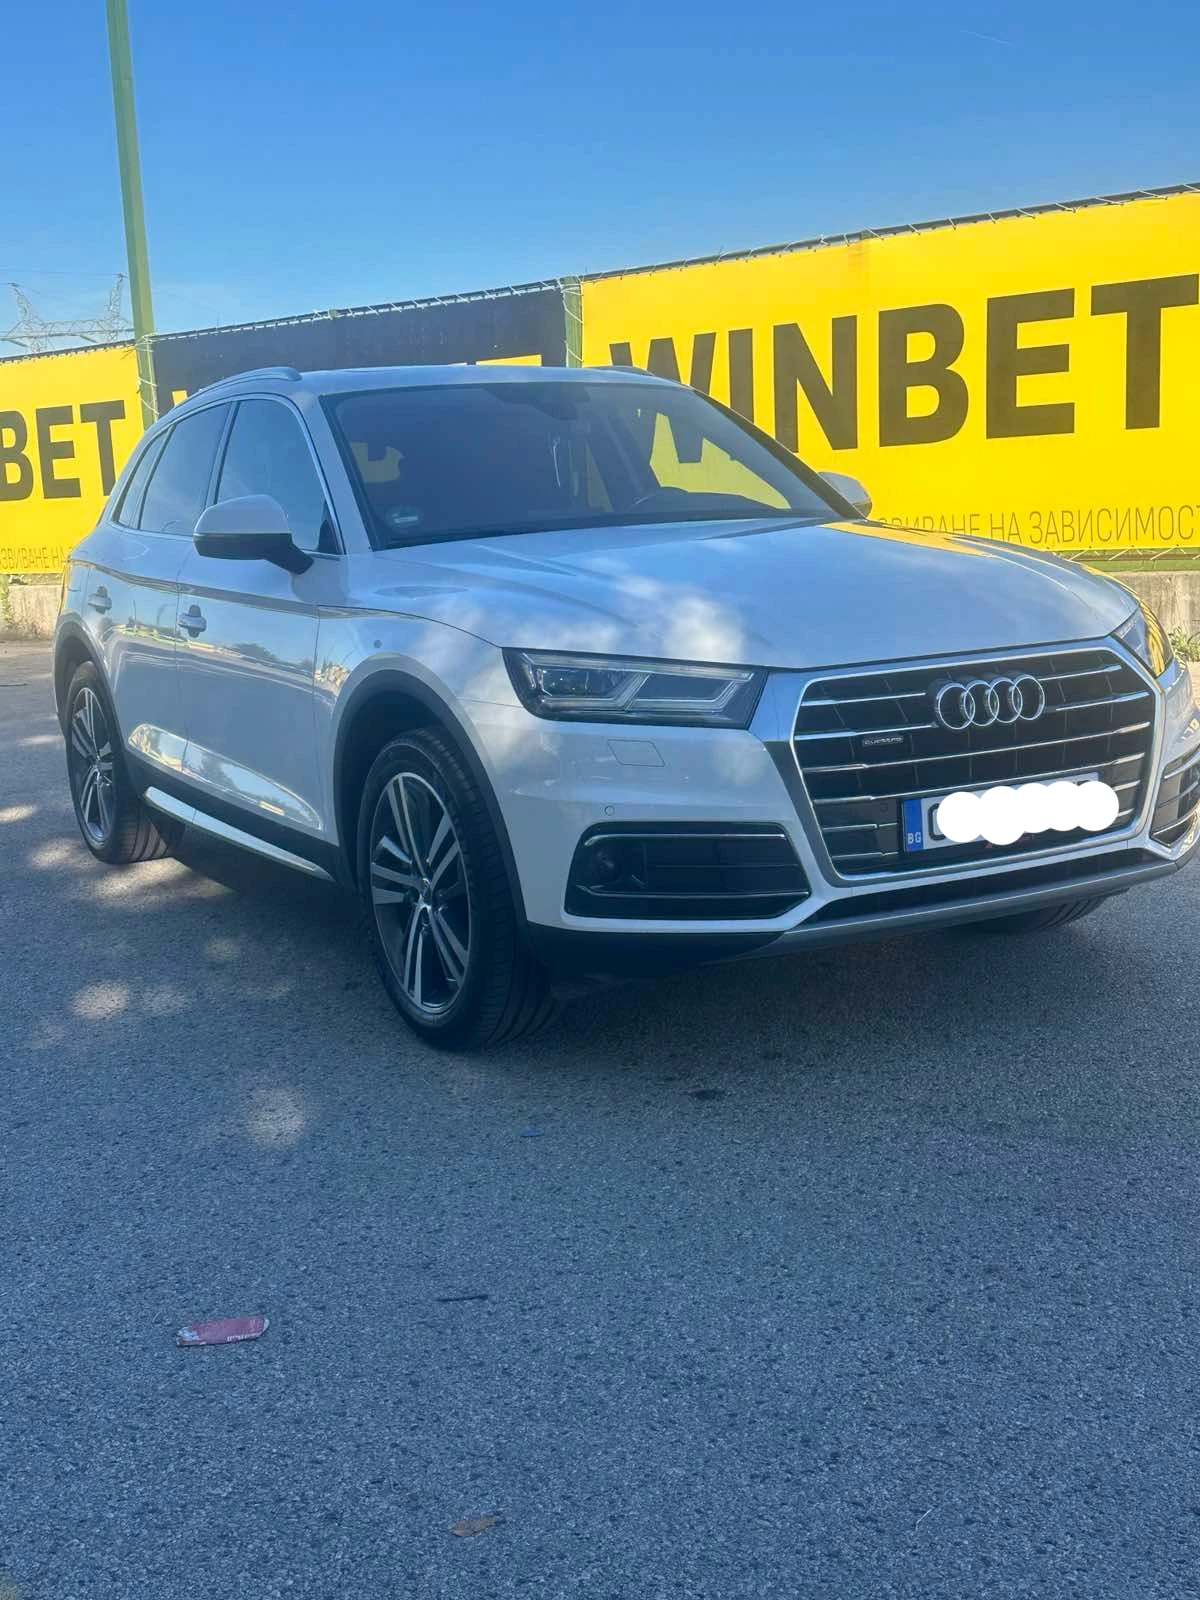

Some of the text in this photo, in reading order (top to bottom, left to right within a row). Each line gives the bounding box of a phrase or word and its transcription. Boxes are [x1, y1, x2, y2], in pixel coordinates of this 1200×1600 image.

[0, 400, 126, 501] BET
[990, 511, 1022, 544] НА
[1029, 504, 1200, 544] ЗАВИСИМОС
[907, 832, 922, 844] BG
